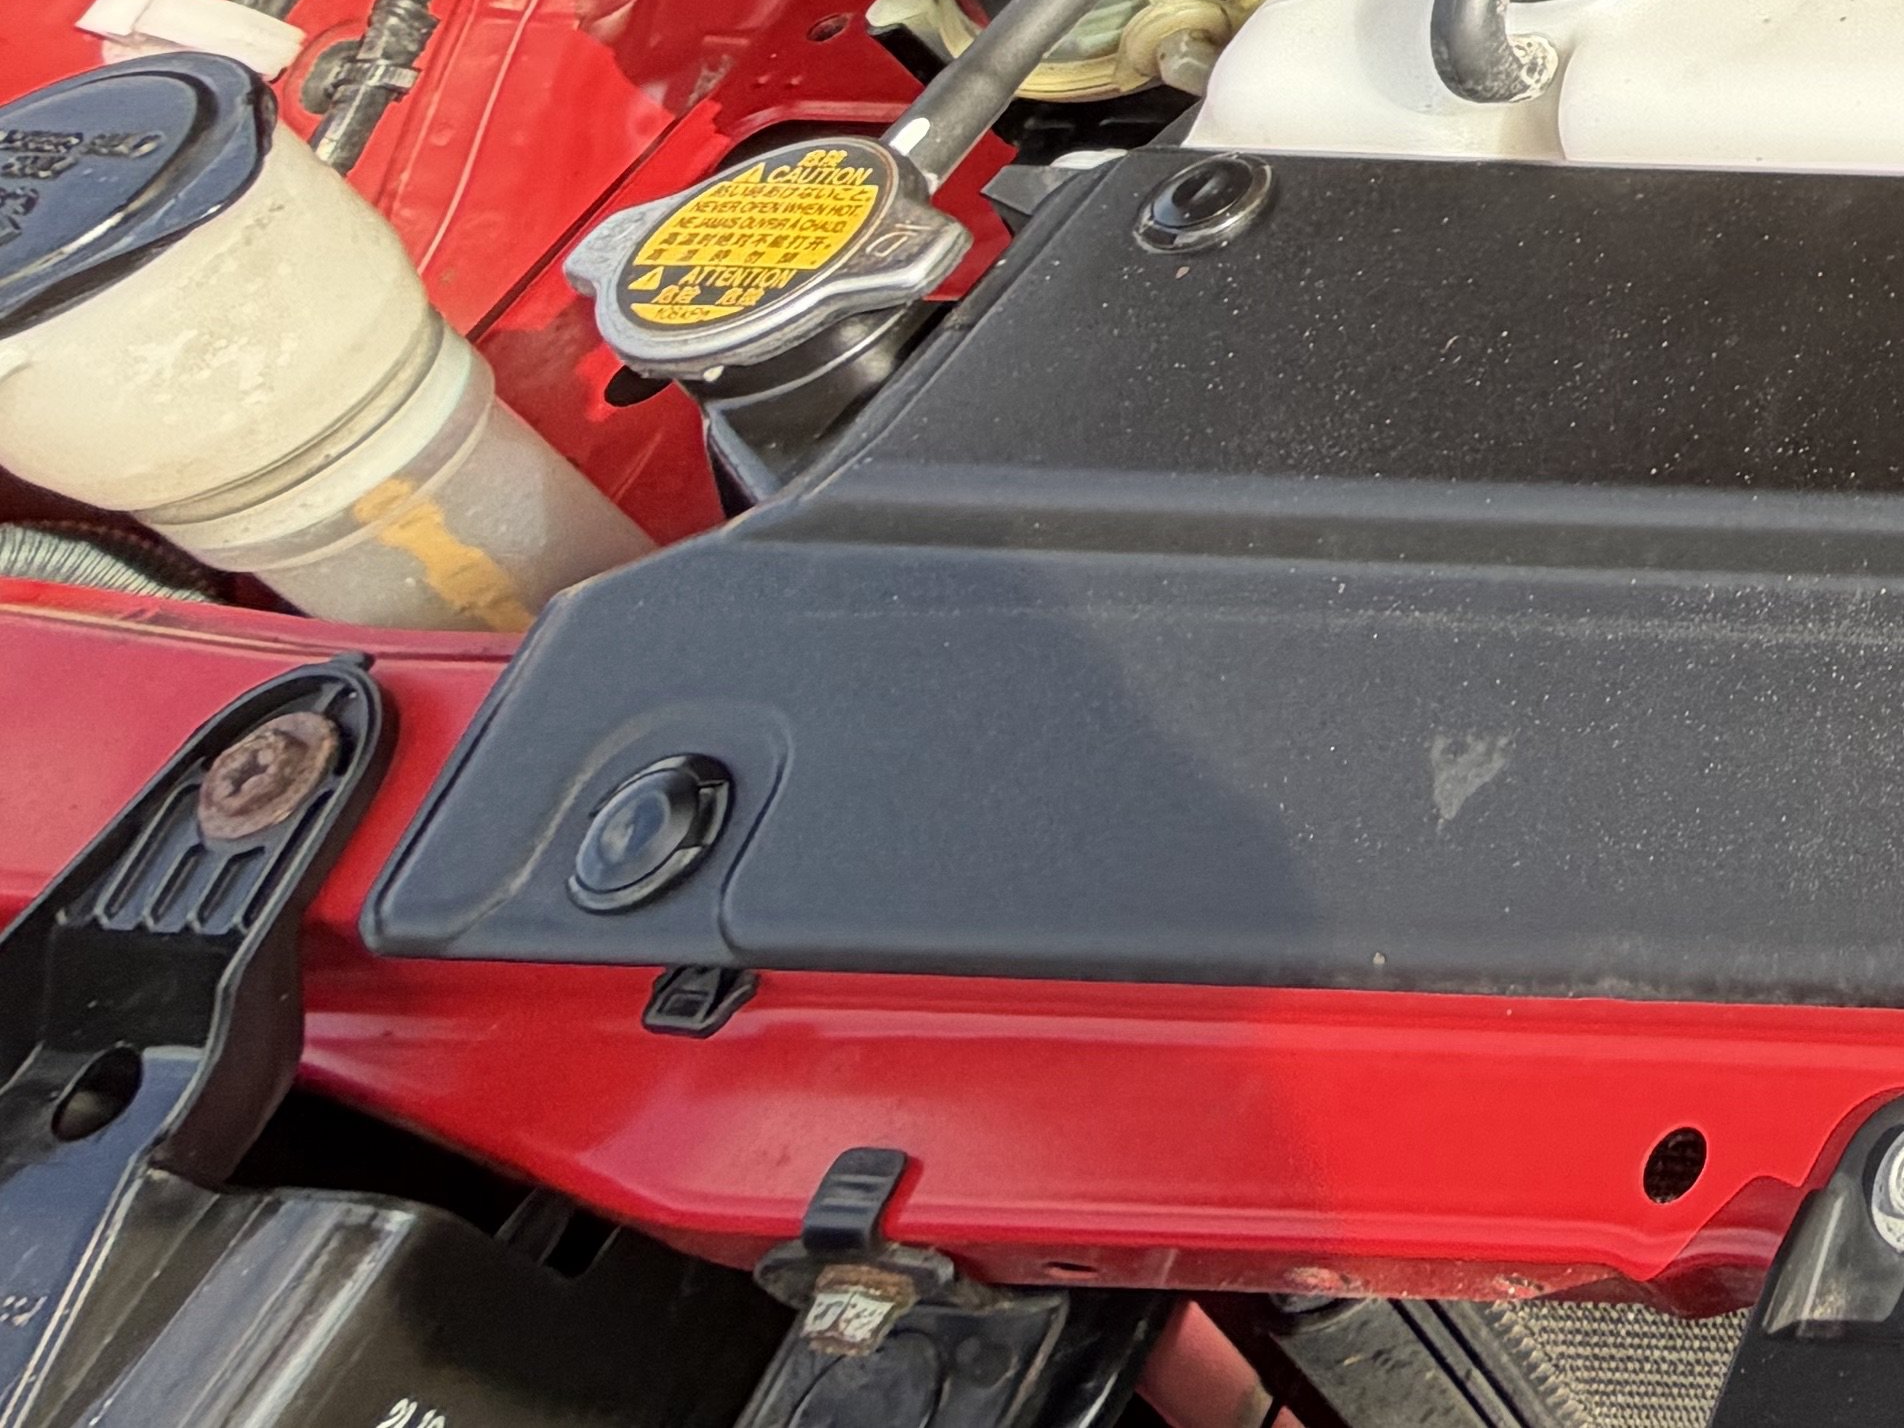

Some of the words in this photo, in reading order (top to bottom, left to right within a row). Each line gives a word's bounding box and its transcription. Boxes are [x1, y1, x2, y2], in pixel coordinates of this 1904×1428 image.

[766, 166, 873, 186] CAUTION
[691, 200, 742, 214] NEVER
[739, 201, 781, 215] OPEN
[781, 202, 828, 216] WHEN
[677, 266, 798, 290] ATTENTION
